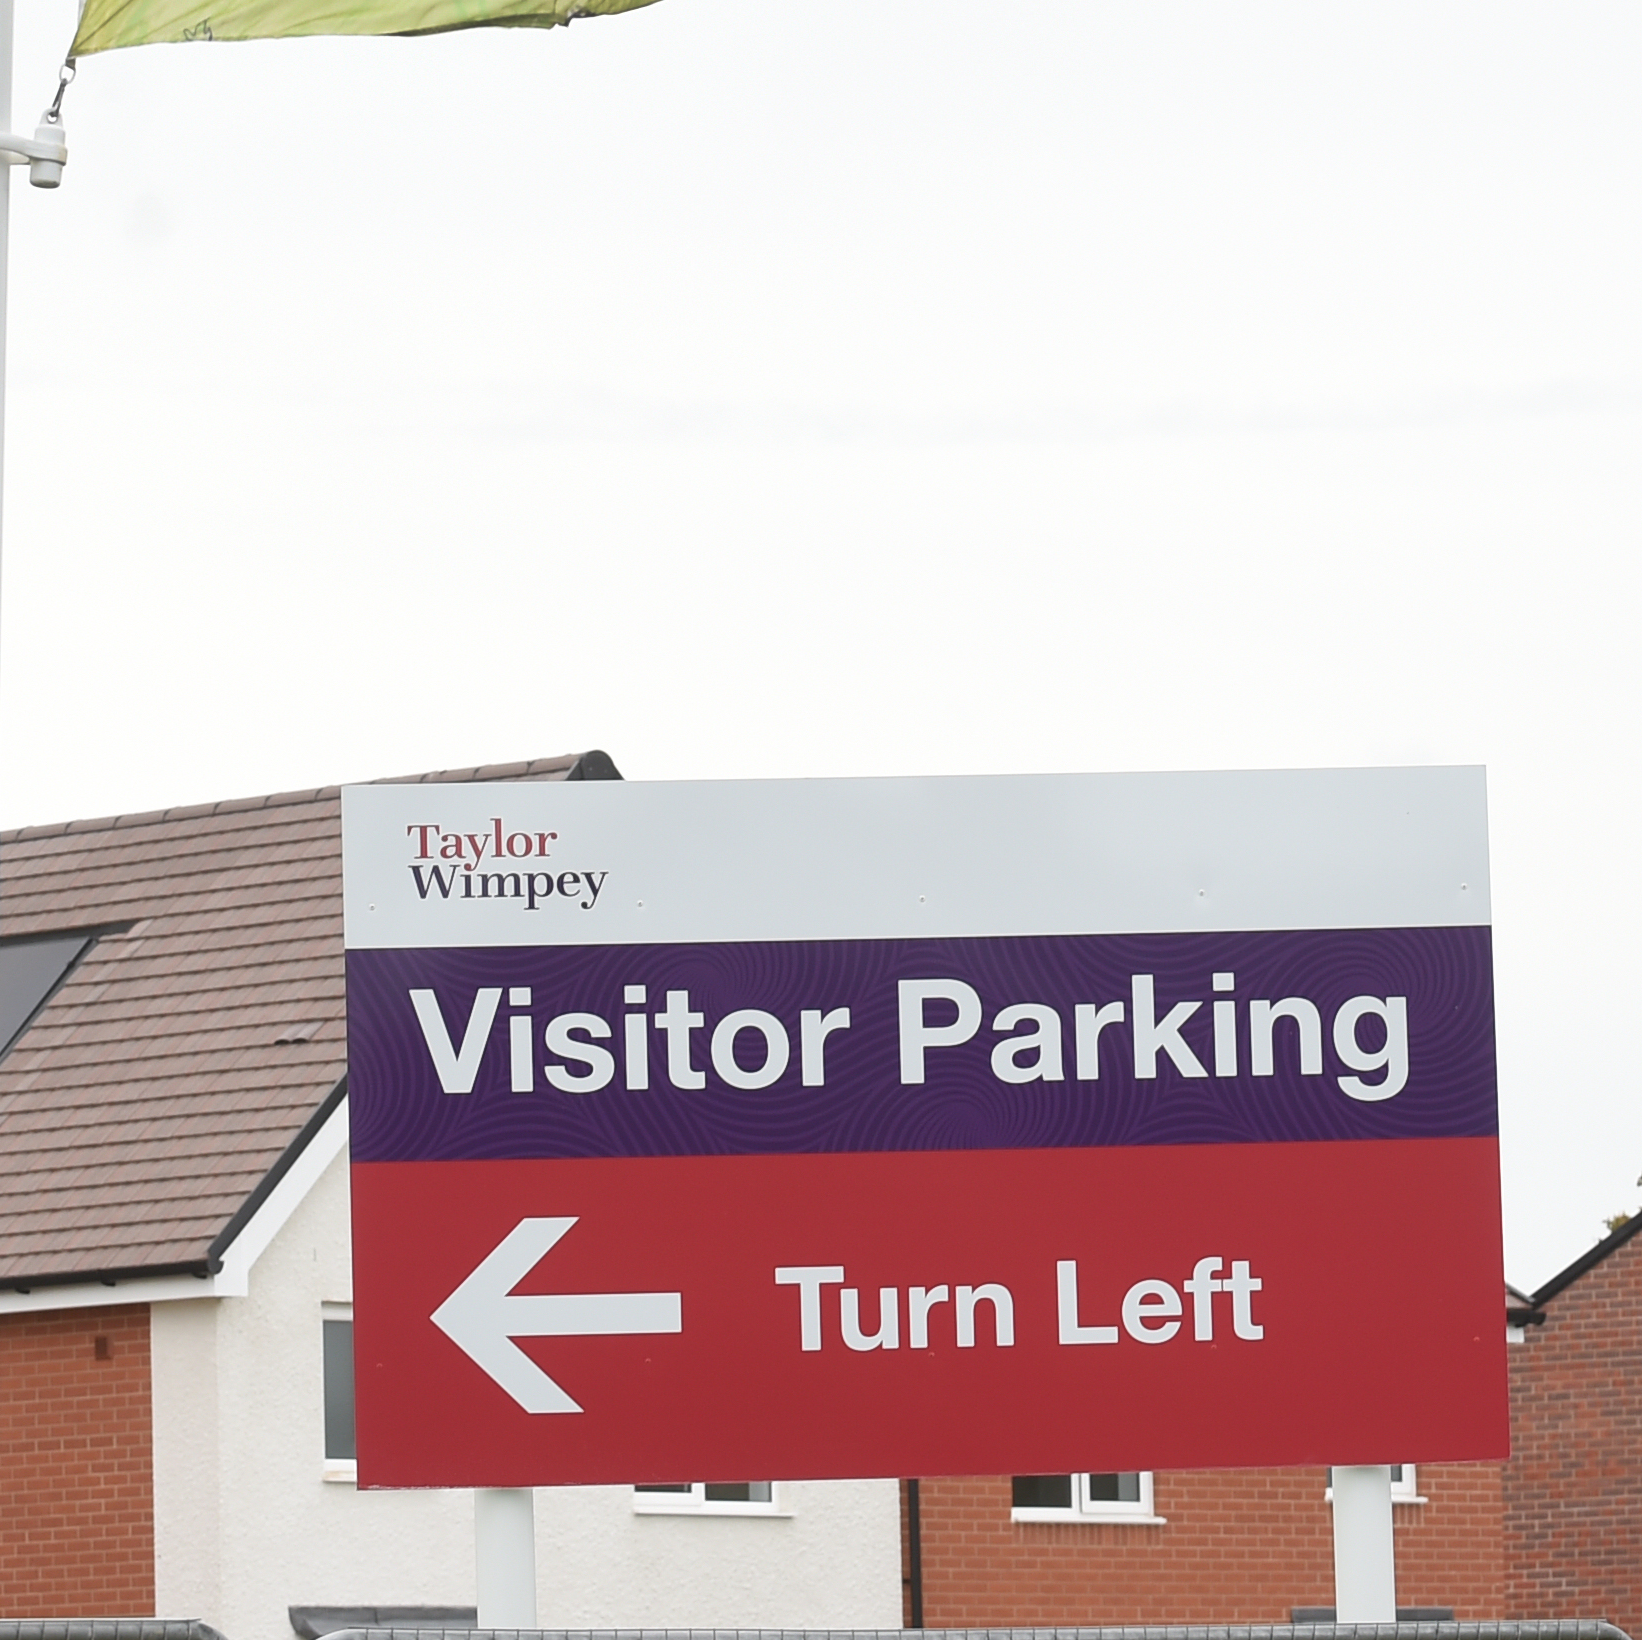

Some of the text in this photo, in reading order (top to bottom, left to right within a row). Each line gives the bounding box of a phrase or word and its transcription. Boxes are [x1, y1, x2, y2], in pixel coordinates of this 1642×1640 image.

[407, 818, 558, 871] Taylor
[409, 863, 609, 911] Wimpey
[409, 972, 1409, 1102] Visitor Parking
[774, 1256, 1264, 1352] Turn Left
